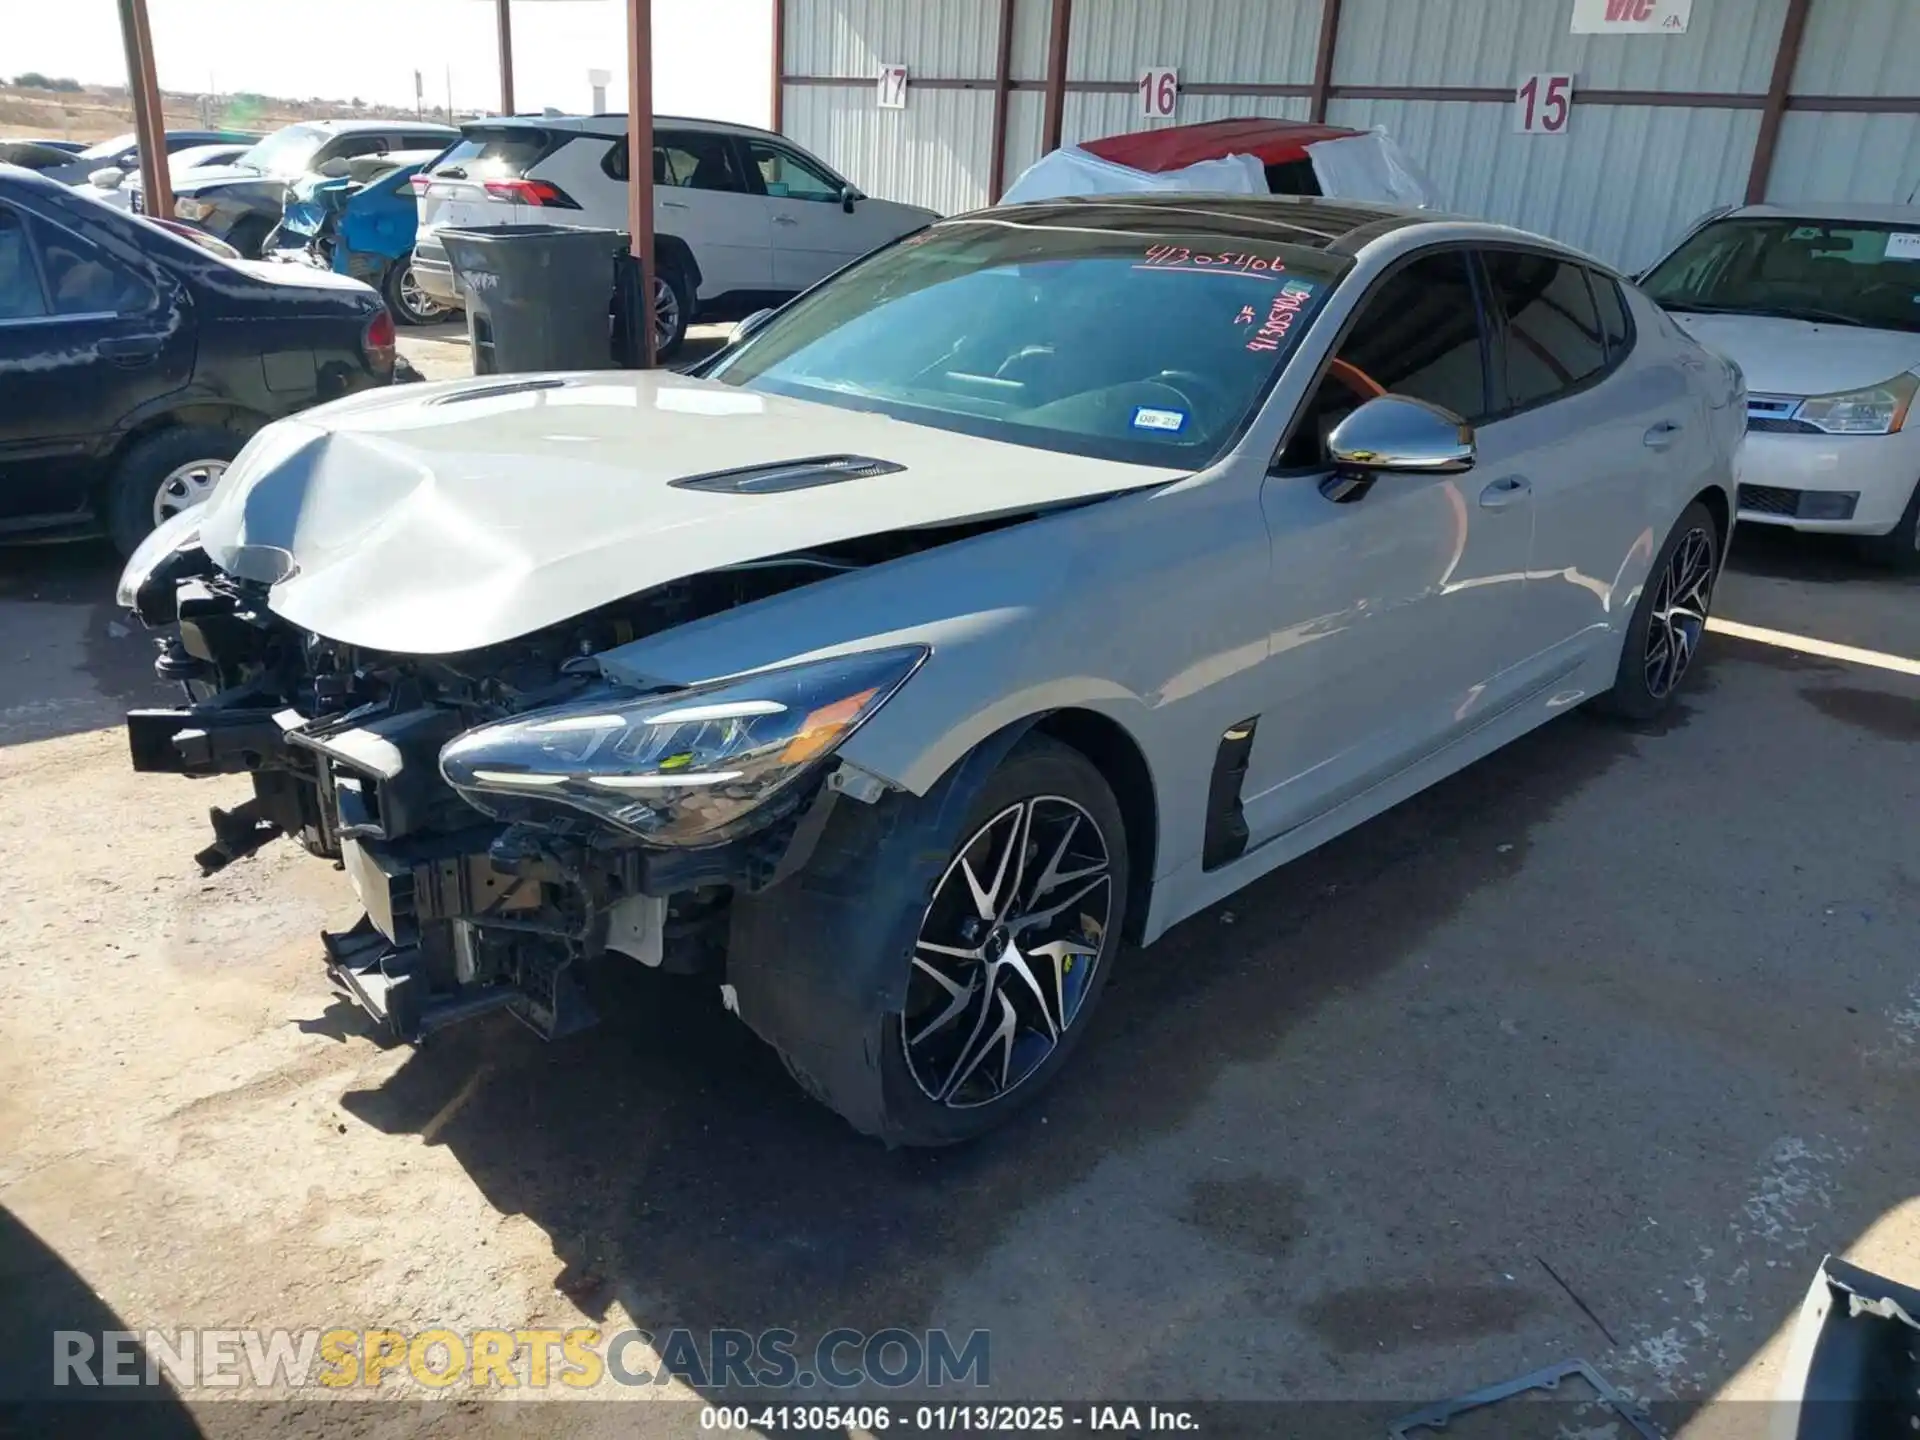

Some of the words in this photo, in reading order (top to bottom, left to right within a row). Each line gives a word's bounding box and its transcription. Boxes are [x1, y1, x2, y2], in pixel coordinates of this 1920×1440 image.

[879, 68, 906, 105] 17
[1140, 72, 1176, 115] 16
[1519, 76, 1570, 132] 15
[1145, 243, 1286, 273] 41305406
